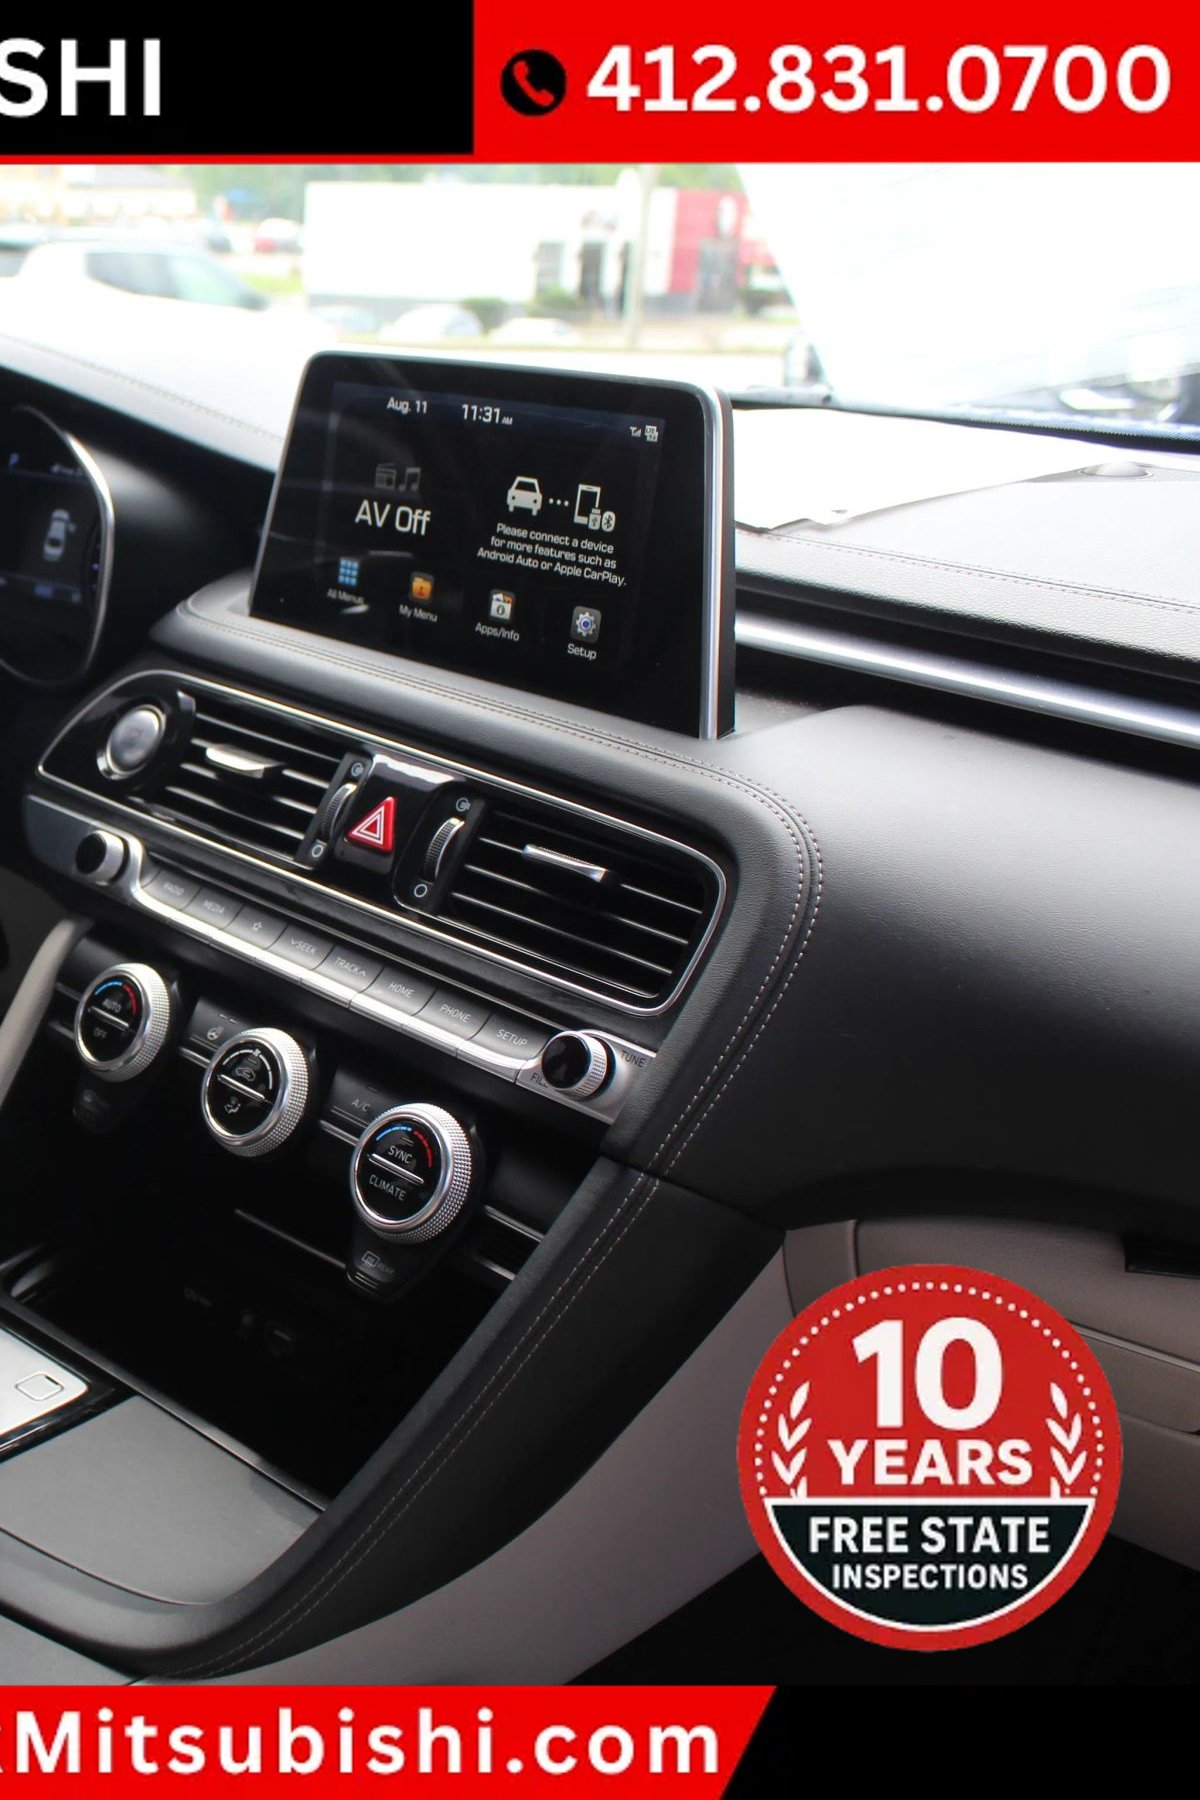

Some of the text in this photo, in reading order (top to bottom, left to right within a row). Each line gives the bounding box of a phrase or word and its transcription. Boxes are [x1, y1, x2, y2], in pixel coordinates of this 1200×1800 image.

[387, 397, 428, 414] Aug. 11
[462, 403, 501, 424] 11:31
[355, 499, 431, 536] AV Off
[496, 522, 614, 554] Please connect a device
[490, 535, 617, 570] for more features such as
[477, 547, 627, 588] Android Auto or Apple CarPlay.
[338, 588, 365, 605] Menus
[399, 603, 438, 623] My Menu
[475, 622, 520, 642] Apps/Info
[567, 643, 597, 661] Setup
[388, 981, 415, 999] HOME
[439, 1003, 472, 1024] PHONE
[496, 1029, 528, 1047] SETUP
[622, 1050, 647, 1068] TUNE
[352, 1099, 371, 1113] A/C
[387, 1145, 414, 1165] SYNC
[369, 1174, 407, 1201] CLIMATE
